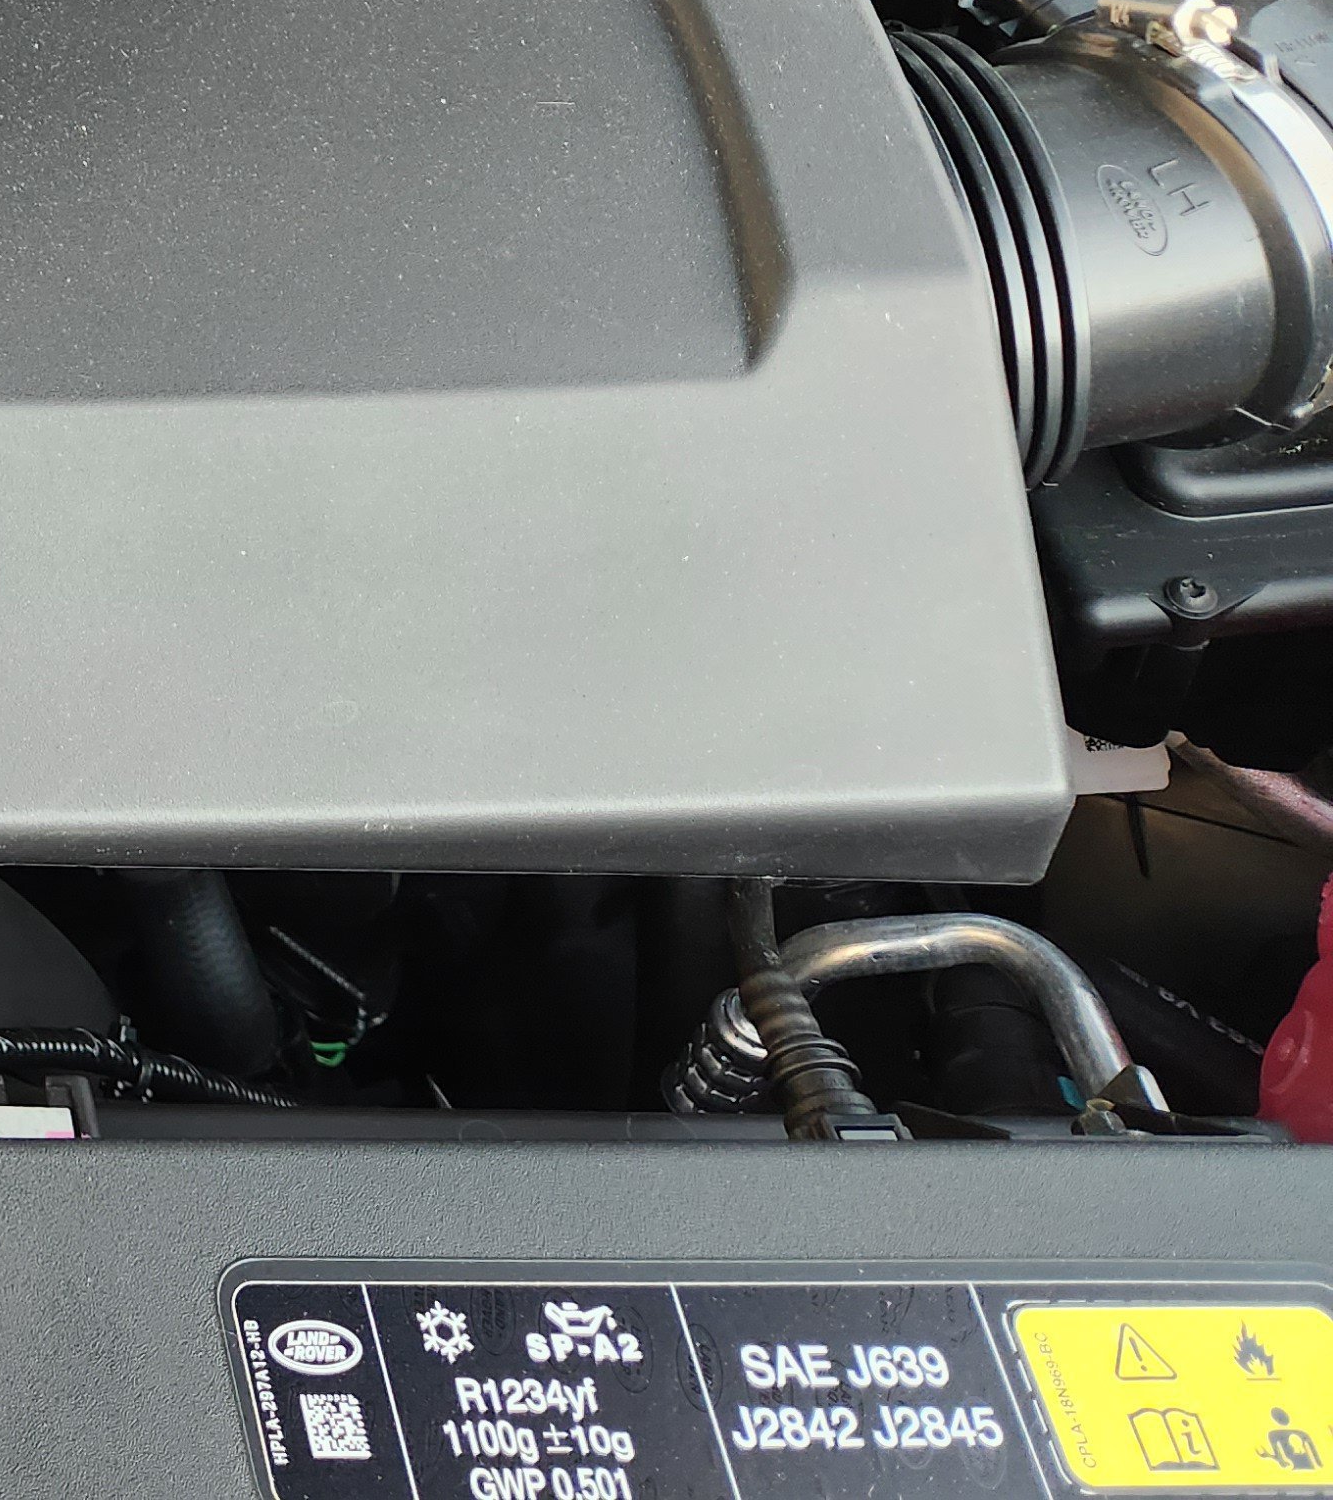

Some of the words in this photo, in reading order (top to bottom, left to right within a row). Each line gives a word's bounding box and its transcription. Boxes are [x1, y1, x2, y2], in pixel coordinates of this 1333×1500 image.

[1146, 157, 1211, 216] LH
[286, 1330, 330, 1348] LAND
[293, 1344, 348, 1363] ROVER
[525, 1332, 644, 1363] SP-A2
[739, 1343, 840, 1389] SAE
[846, 1344, 950, 1389] J639
[455, 1376, 599, 1422] R1234yf
[442, 1419, 540, 1466] 1100g
[542, 1422, 636, 1464] ±10g
[732, 1404, 865, 1450] J2842
[872, 1405, 1004, 1450] J2845
[469, 1466, 546, 1500] GWP
